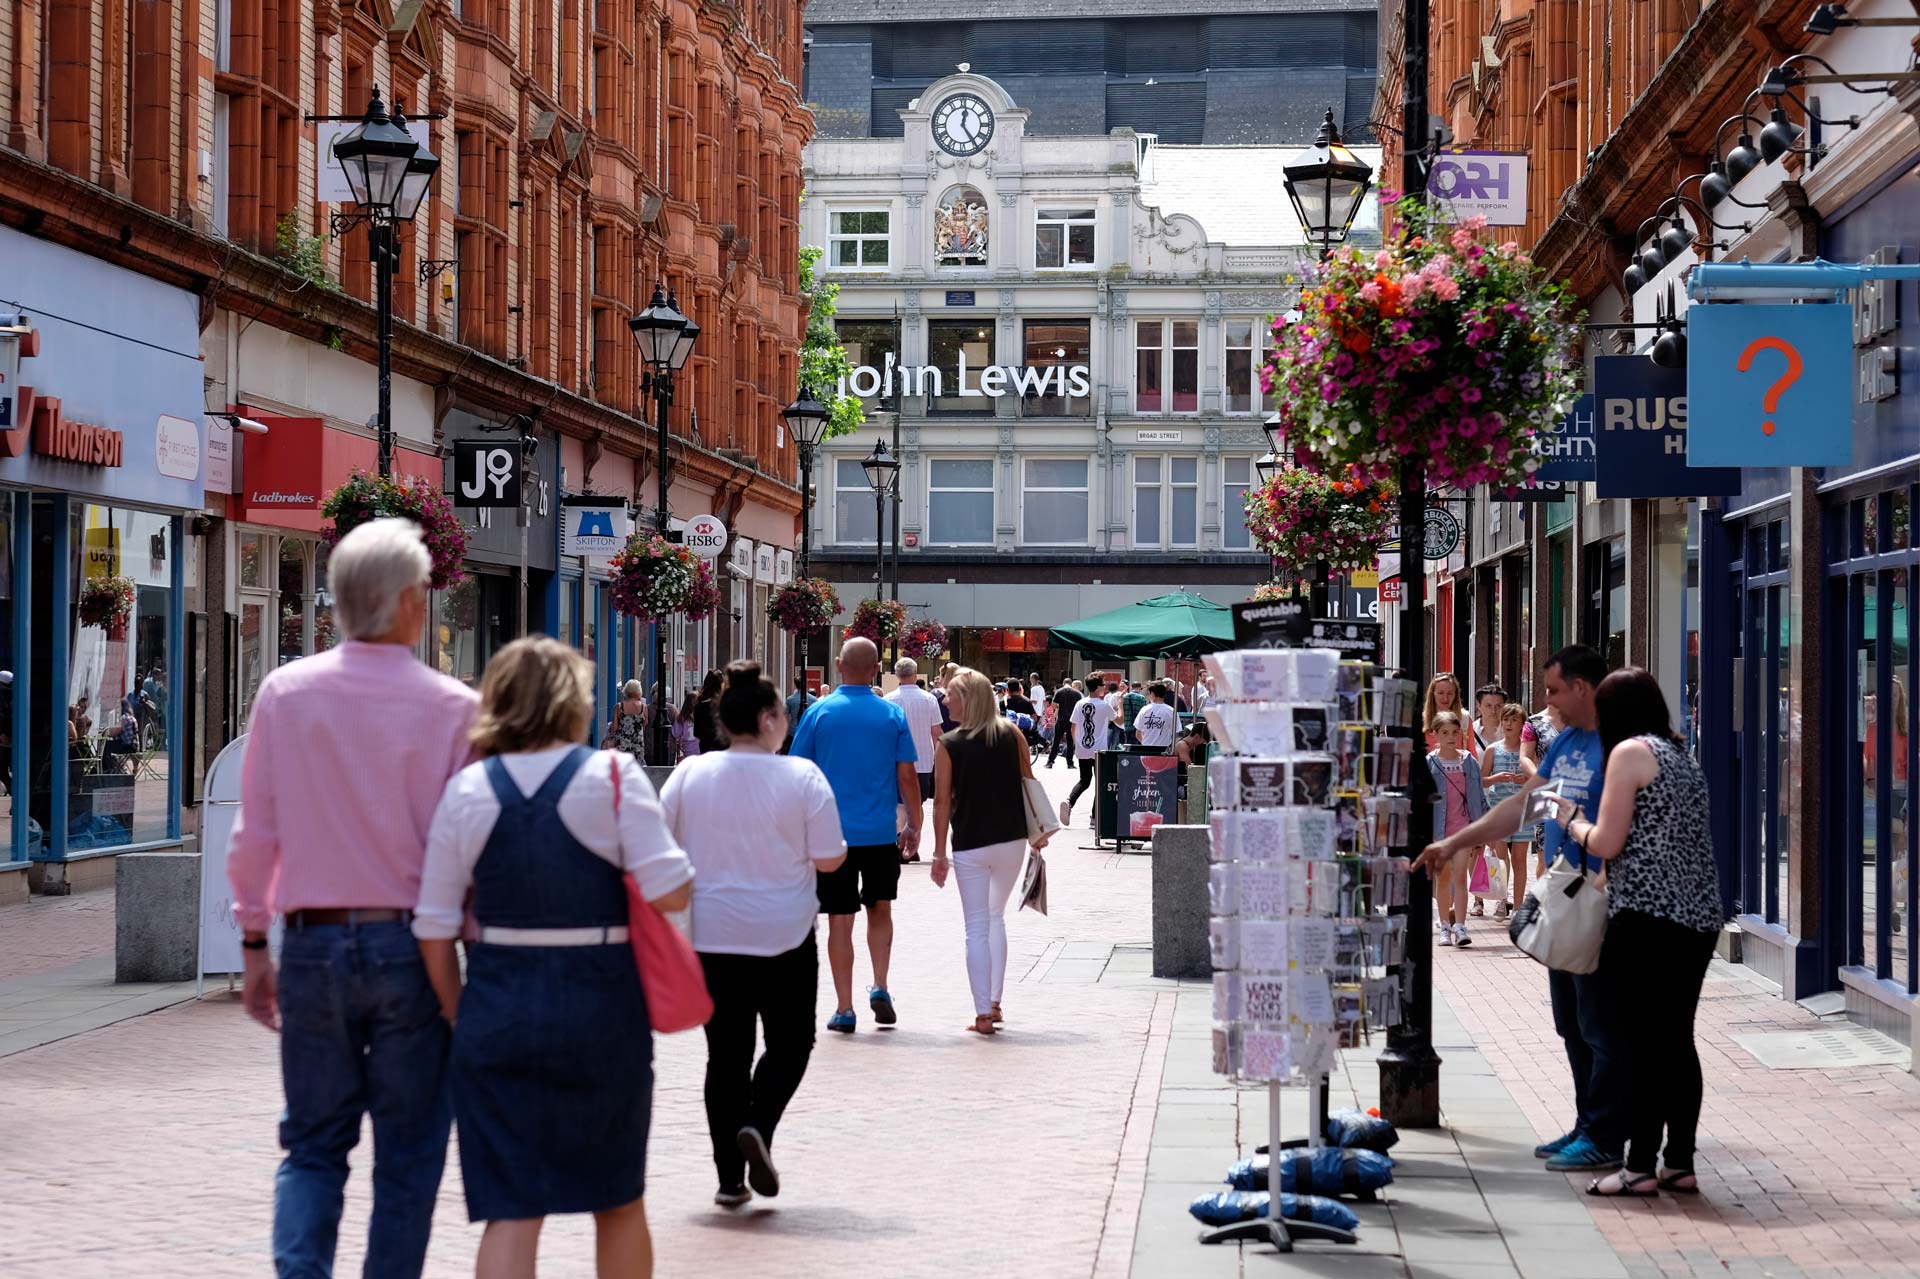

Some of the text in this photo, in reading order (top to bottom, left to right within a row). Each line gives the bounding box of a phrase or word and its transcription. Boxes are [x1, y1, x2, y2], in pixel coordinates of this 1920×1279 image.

[1428, 161, 1510, 199] ORH
[958, 348, 1090, 398] Lewis
[1604, 397, 1688, 431] RUS
[40, 396, 124, 468] Thomson
[461, 448, 513, 499] JOY
[252, 492, 315, 503] Ladbrokes
[538, 479, 548, 517] 26
[1423, 511, 1455, 532] RBUCKS
[576, 537, 616, 546] SKIPTON
[686, 535, 723, 547] HSBC
[1423, 542, 1451, 556] OFFEE
[1385, 582, 1400, 591] FLI
[1241, 601, 1302, 622] quotable
[1132, 785, 1161, 801] shaken
[1245, 982, 1283, 992] LEARN
[1248, 991, 1280, 1001] FROM
[1246, 1001, 1281, 1011] EVERY
[1248, 1010, 1282, 1020] THING
